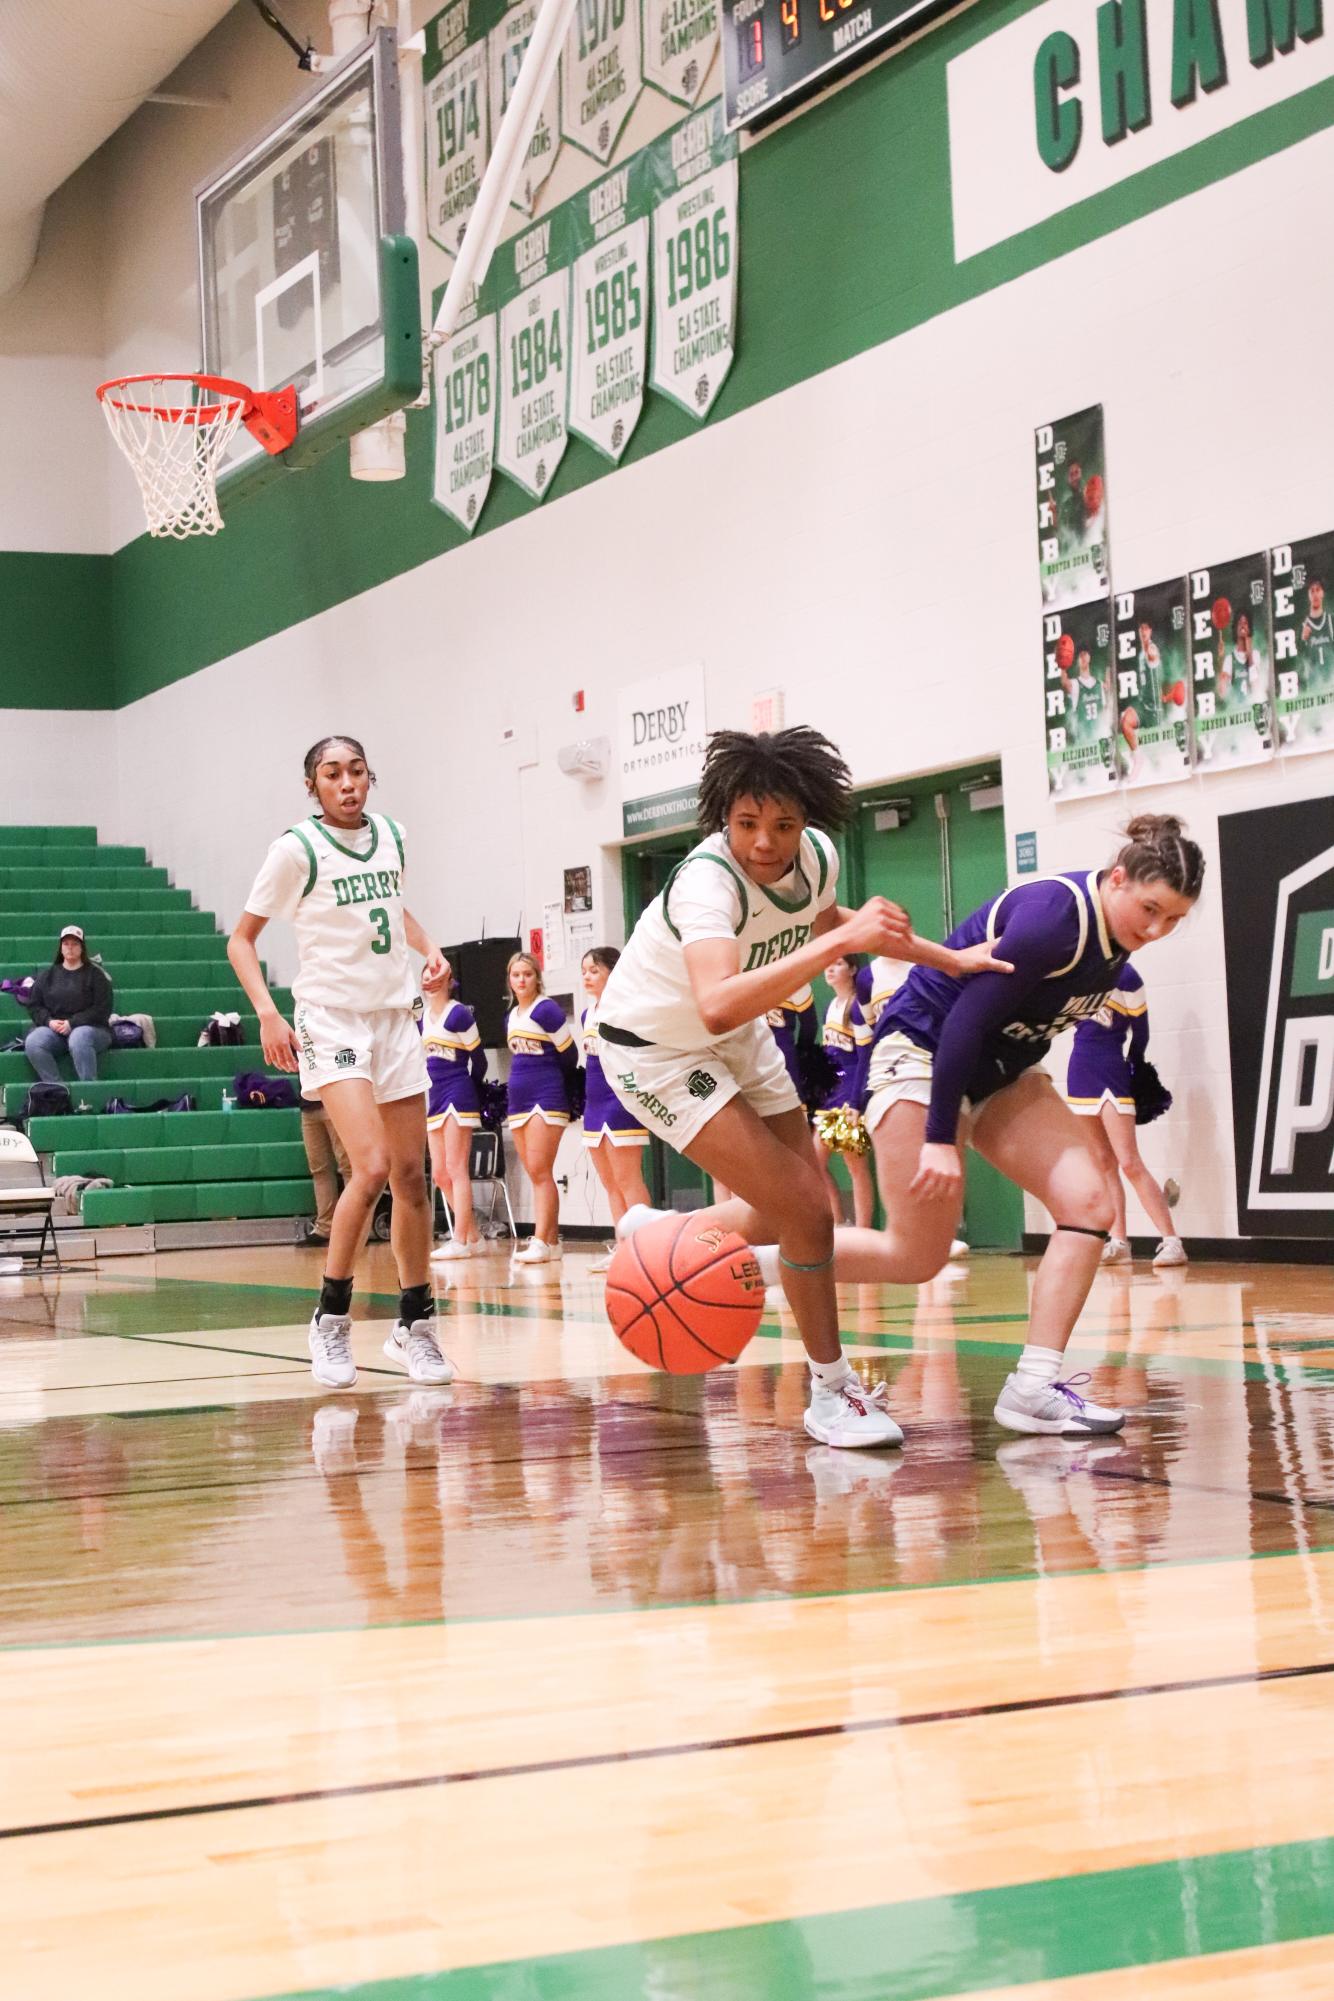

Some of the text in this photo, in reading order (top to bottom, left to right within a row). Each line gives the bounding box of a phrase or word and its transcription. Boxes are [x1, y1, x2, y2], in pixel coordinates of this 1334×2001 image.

[832, 8, 872, 53] MATCH
[580, 68, 626, 126] CHAMPIONS
[735, 78, 769, 114] SCORE
[437, 79, 480, 168] 1974
[667, 205, 731, 308] 1986
[586, 261, 642, 355] 1985
[677, 297, 721, 343] 6A STATE
[511, 308, 563, 398] 1984
[609, 346, 634, 382] STATE
[673, 323, 729, 376] CHAMPIONS
[445, 352, 490, 435] 1978
[534, 390, 555, 423] STATE
[591, 372, 640, 419] CHAMPIONS
[464, 428, 485, 460] STATE
[516, 413, 562, 459] CHAMPIONS
[450, 451, 490, 493] CHAMPIONS
[632, 701, 689, 747] DERBY
[623, 742, 704, 774] ORTHODONTICS
[331, 870, 401, 907] DERBY
[368, 907, 391, 955] 3
[1270, 1015, 1334, 1175] P
